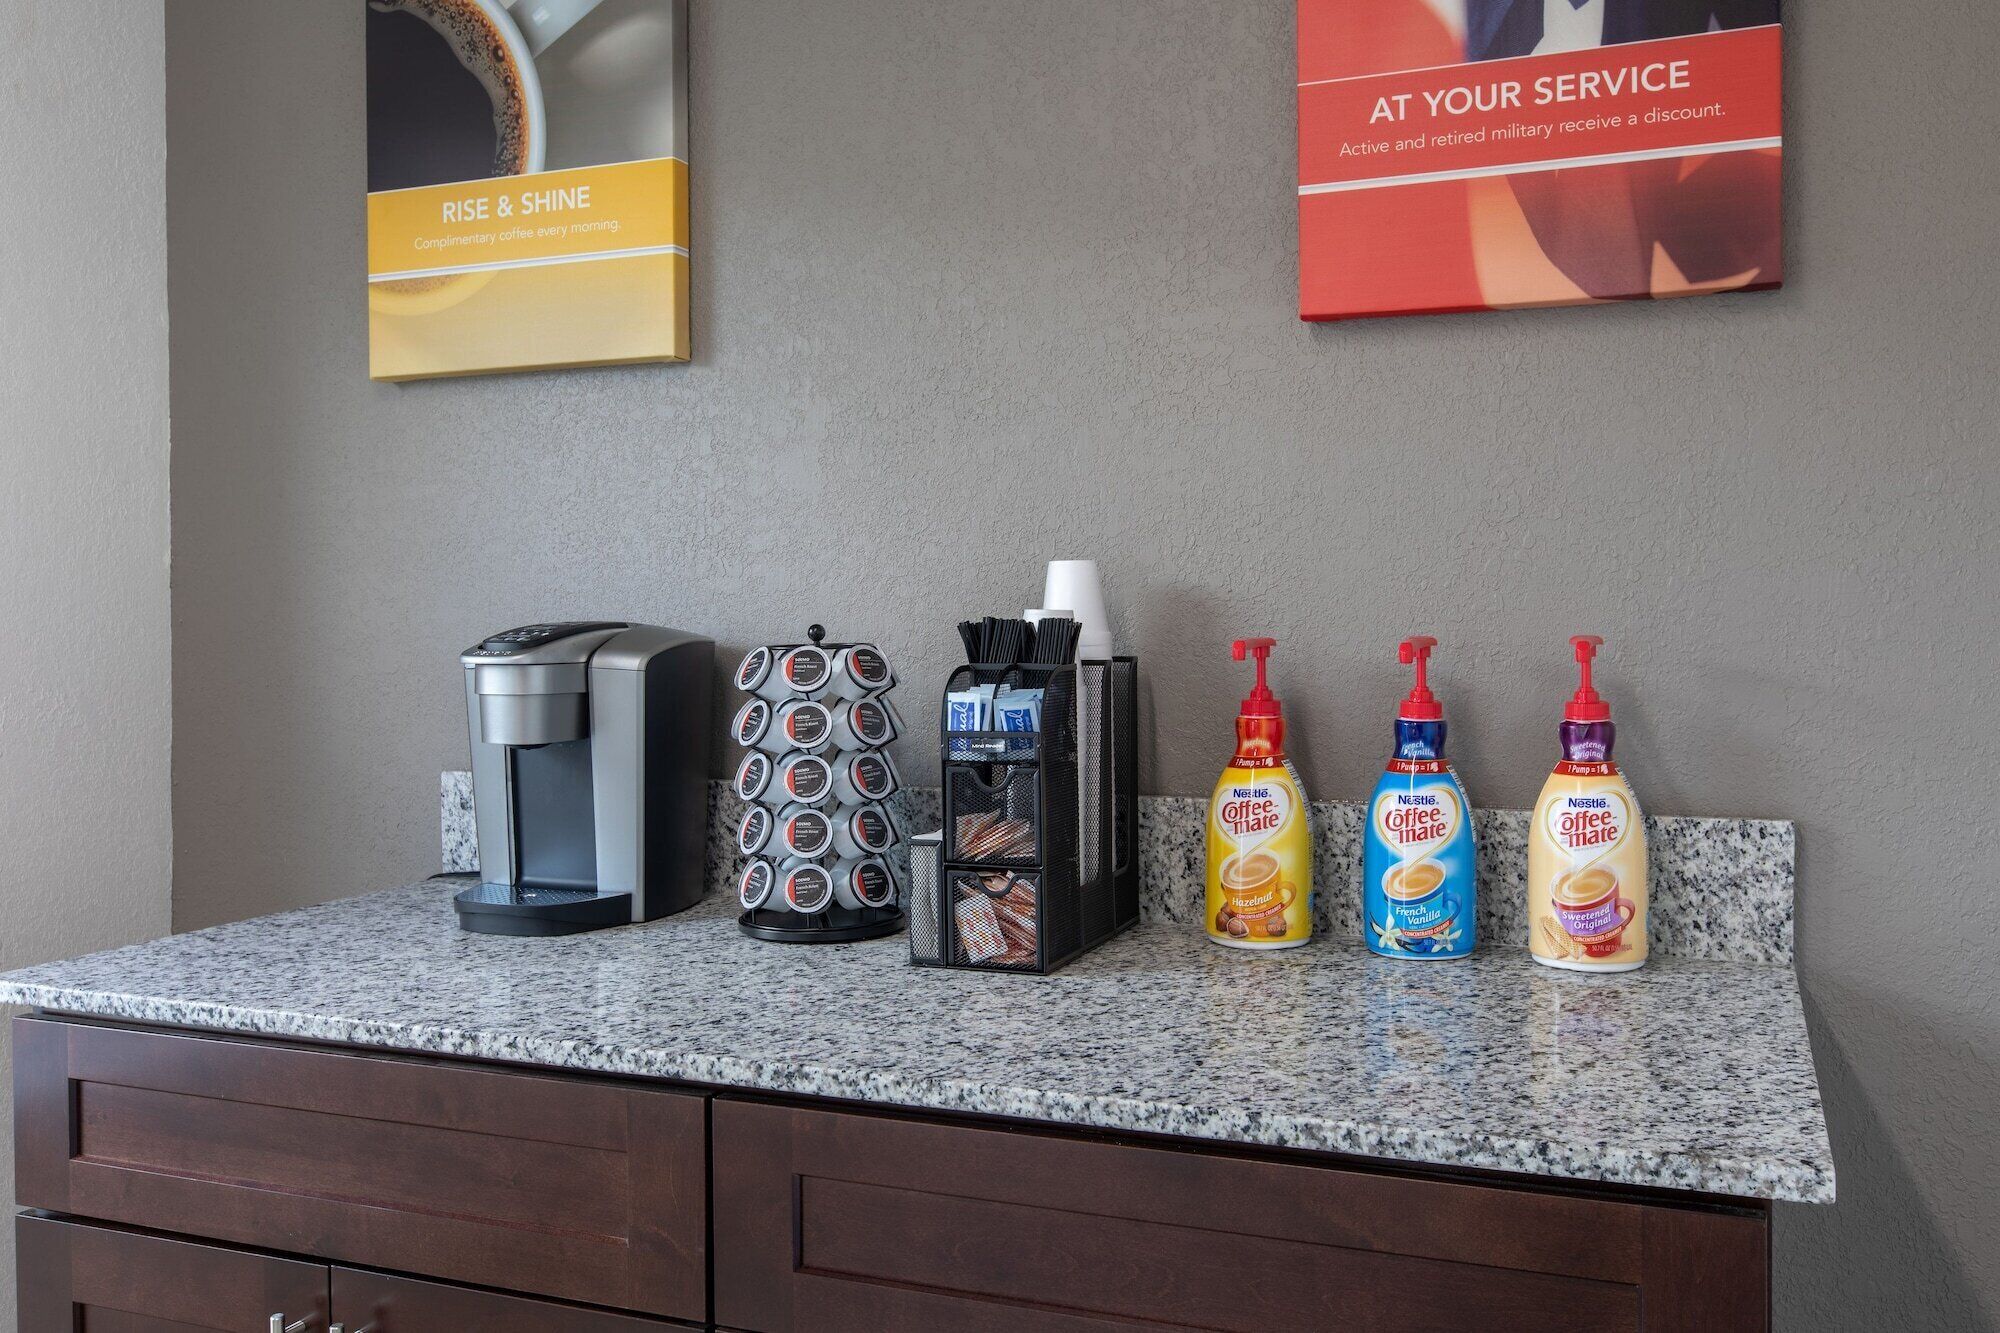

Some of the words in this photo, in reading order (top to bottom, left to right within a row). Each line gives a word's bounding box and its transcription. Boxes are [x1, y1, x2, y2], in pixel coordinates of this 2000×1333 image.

[1369, 93, 1412, 124] AT
[1423, 80, 1522, 117] YOUR
[1533, 60, 1692, 105] SERVICE
[1339, 139, 1390, 158] Active
[1395, 133, 1426, 151] and
[1431, 128, 1486, 147] retired
[1491, 122, 1554, 142] military
[1559, 115, 1622, 133] receive
[1627, 113, 1639, 126] a
[1643, 102, 1726, 124] discount.
[442, 197, 490, 224] RISE
[497, 195, 514, 218] &
[521, 185, 591, 215] SHINE
[414, 231, 497, 251] Complimentary
[499, 226, 534, 242] coffee
[537, 224, 568, 239] every
[571, 217, 622, 233] morning.
[953, 702, 969, 748] ual
[1239, 758, 1255, 768] Pump
[1572, 764, 1590, 776] Pump
[1234, 814, 1279, 835] mate
[1398, 822, 1447, 844] mate
[1568, 826, 1618, 848] mate
[1232, 891, 1274, 907] Hazelnut
[1396, 906, 1427, 917] French
[1407, 910, 1441, 925] Vanilla
[1562, 903, 1610, 921] Sweetened
[1574, 913, 1612, 931] Original
